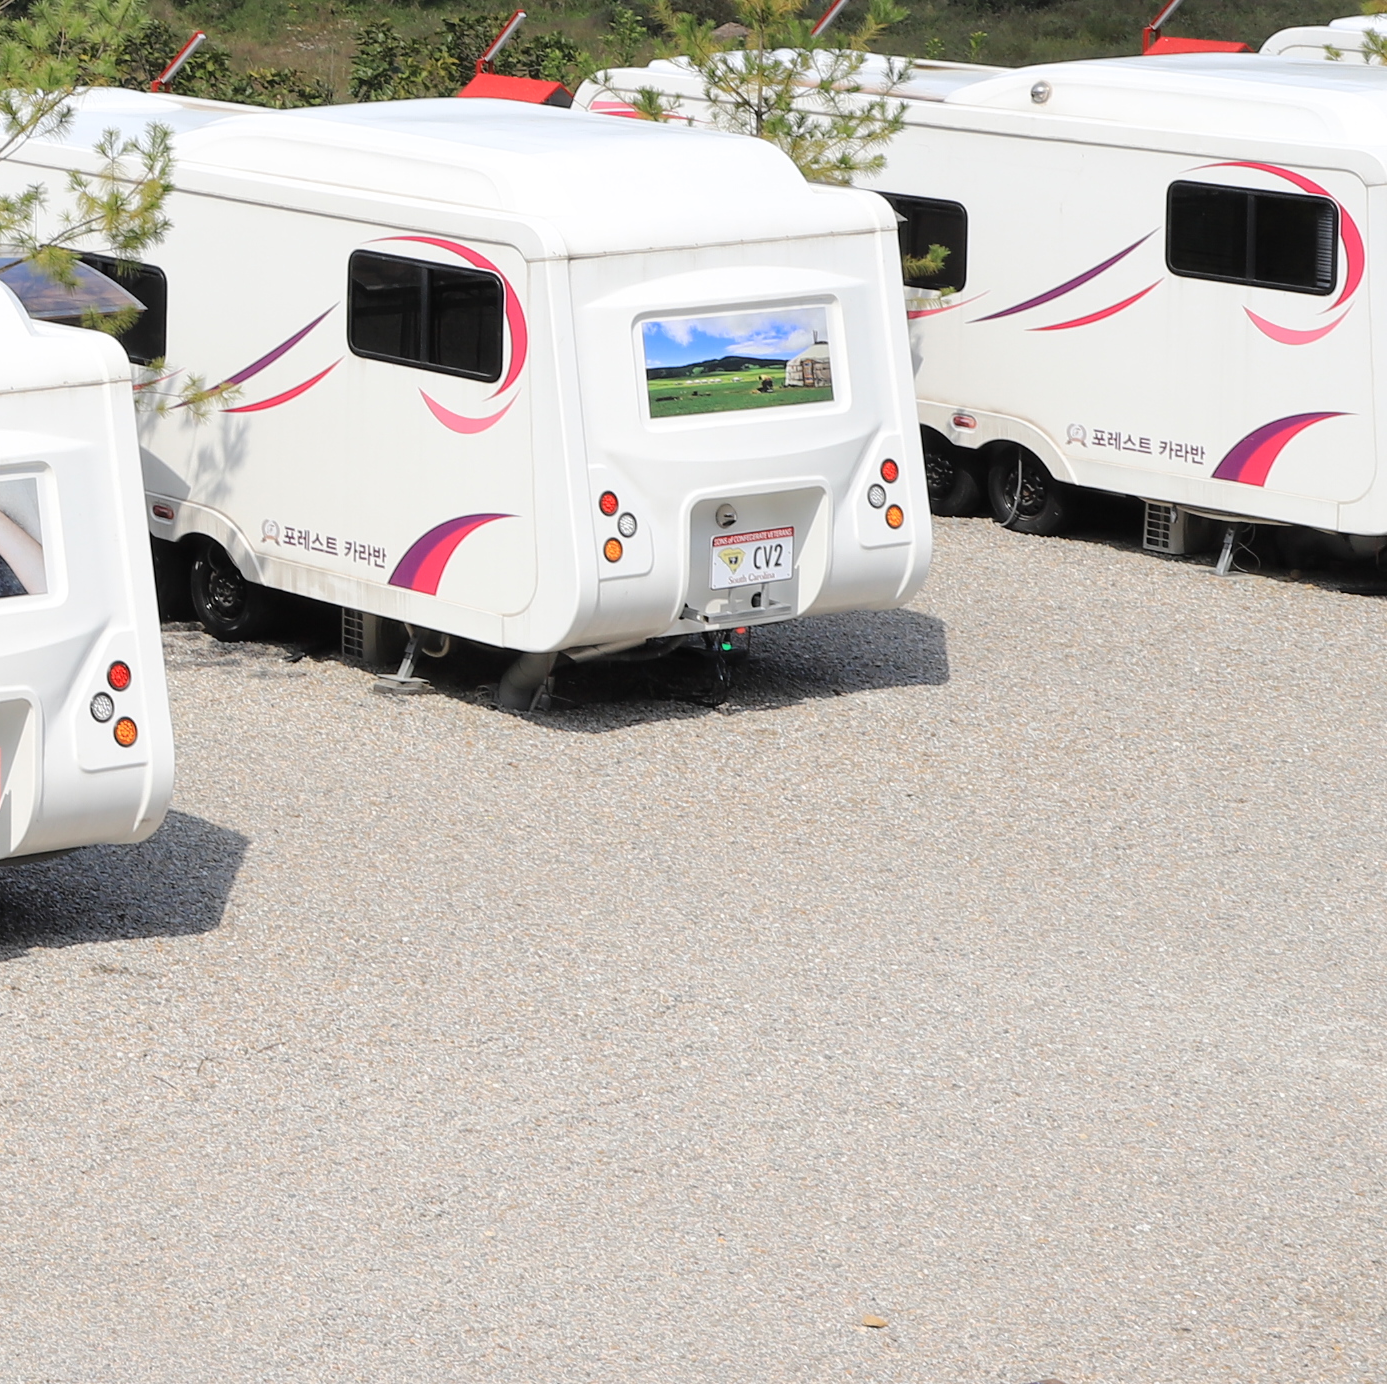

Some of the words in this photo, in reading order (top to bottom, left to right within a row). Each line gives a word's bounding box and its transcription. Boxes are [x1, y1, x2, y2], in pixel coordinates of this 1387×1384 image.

[1091, 428, 1152, 454] 포레스트
[1159, 440, 1206, 465] 카라반
[283, 526, 338, 556] 포레스트
[344, 540, 387, 569] 카라반
[714, 538, 727, 546] SONS
[768, 528, 793, 538] VETERANS
[753, 543, 784, 570] CV2
[728, 575, 748, 585] South
[748, 572, 775, 582] Carolina
